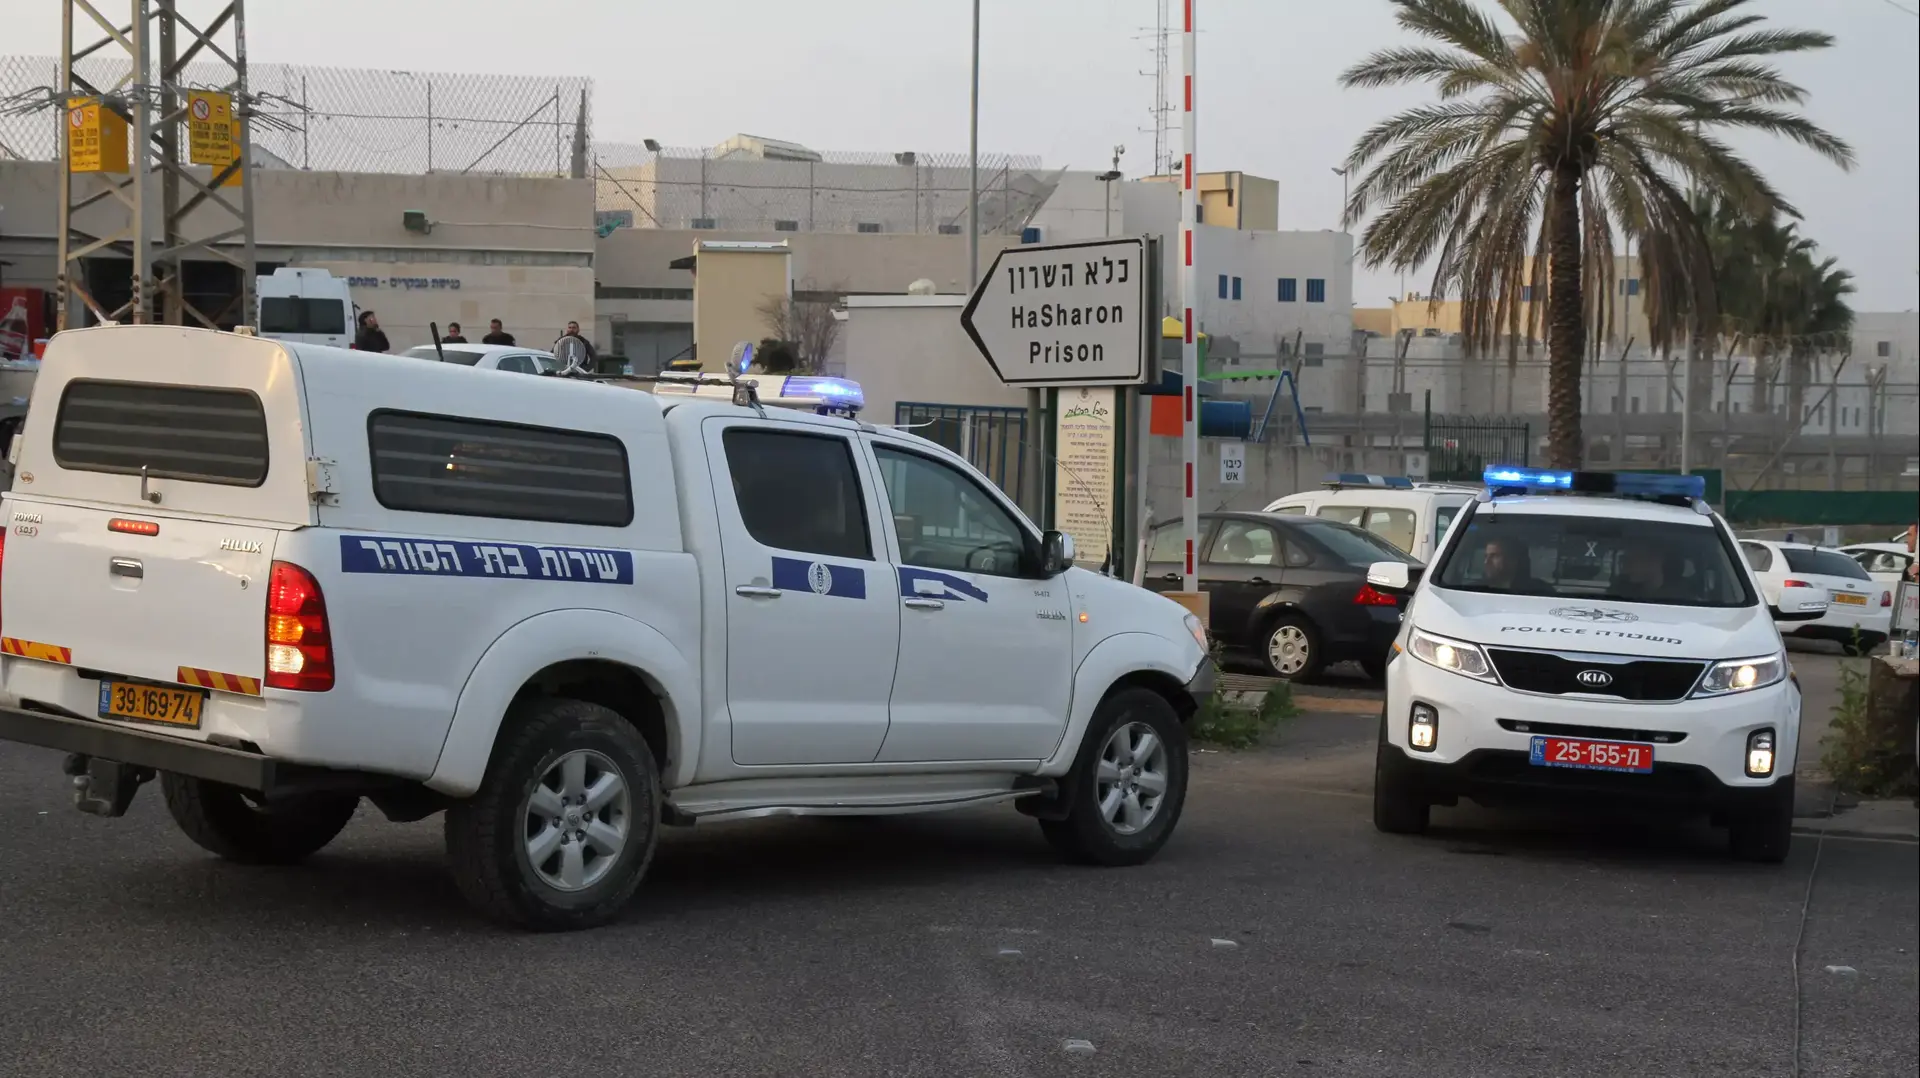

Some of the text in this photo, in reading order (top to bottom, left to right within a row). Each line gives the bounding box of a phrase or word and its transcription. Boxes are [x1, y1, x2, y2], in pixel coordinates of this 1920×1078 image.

[1008, 256, 1129, 294] כלא השרון
[1011, 303, 1123, 329] HaSharon
[1029, 341, 1104, 364] Prison
[1223, 459, 1242, 469] כיבוי
[1225, 471, 1239, 481] אש
[14, 512, 43, 524] TOYOTA
[220, 538, 263, 554] HILUX
[359, 539, 619, 580] שירות בתי הסוהר
[1500, 626, 1683, 645] POLICE משטרה
[1583, 672, 1606, 683] KIA
